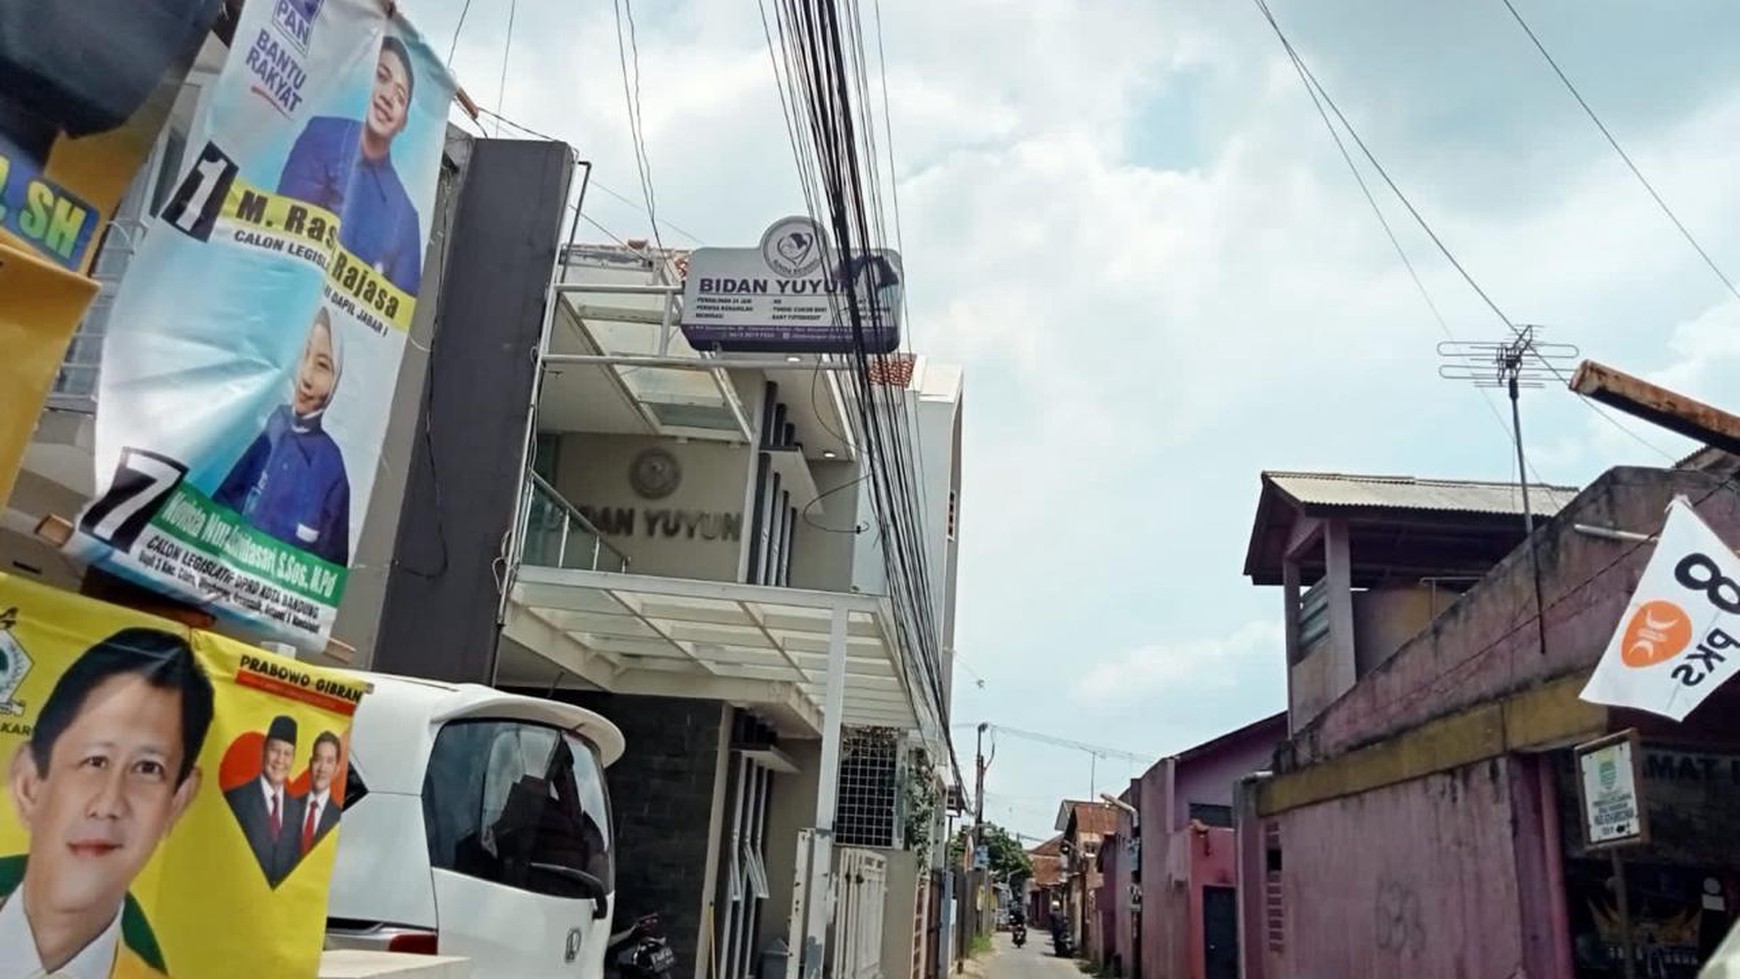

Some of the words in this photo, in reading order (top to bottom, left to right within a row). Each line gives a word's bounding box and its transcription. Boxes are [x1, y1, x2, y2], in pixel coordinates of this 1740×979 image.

[277, 0, 310, 46] PAN
[246, 46, 302, 112] RAKYAT
[256, 28, 306, 90] BANTU
[19, 181, 87, 259] SH
[176, 159, 228, 231] 1
[234, 230, 284, 251] CALON
[331, 292, 356, 316] DAPIL
[356, 309, 383, 332] JABAR
[235, 190, 273, 228] M.
[331, 252, 400, 319] Rajasa
[700, 278, 767, 293] BIDAN
[92, 452, 182, 541] 7
[644, 507, 741, 541] YUYUN
[147, 535, 182, 561] CALON
[182, 550, 235, 583] LEGISLATIF
[260, 584, 281, 604] KOTA
[240, 654, 310, 686] PRABOWO
[315, 678, 362, 703] GIBRAN
